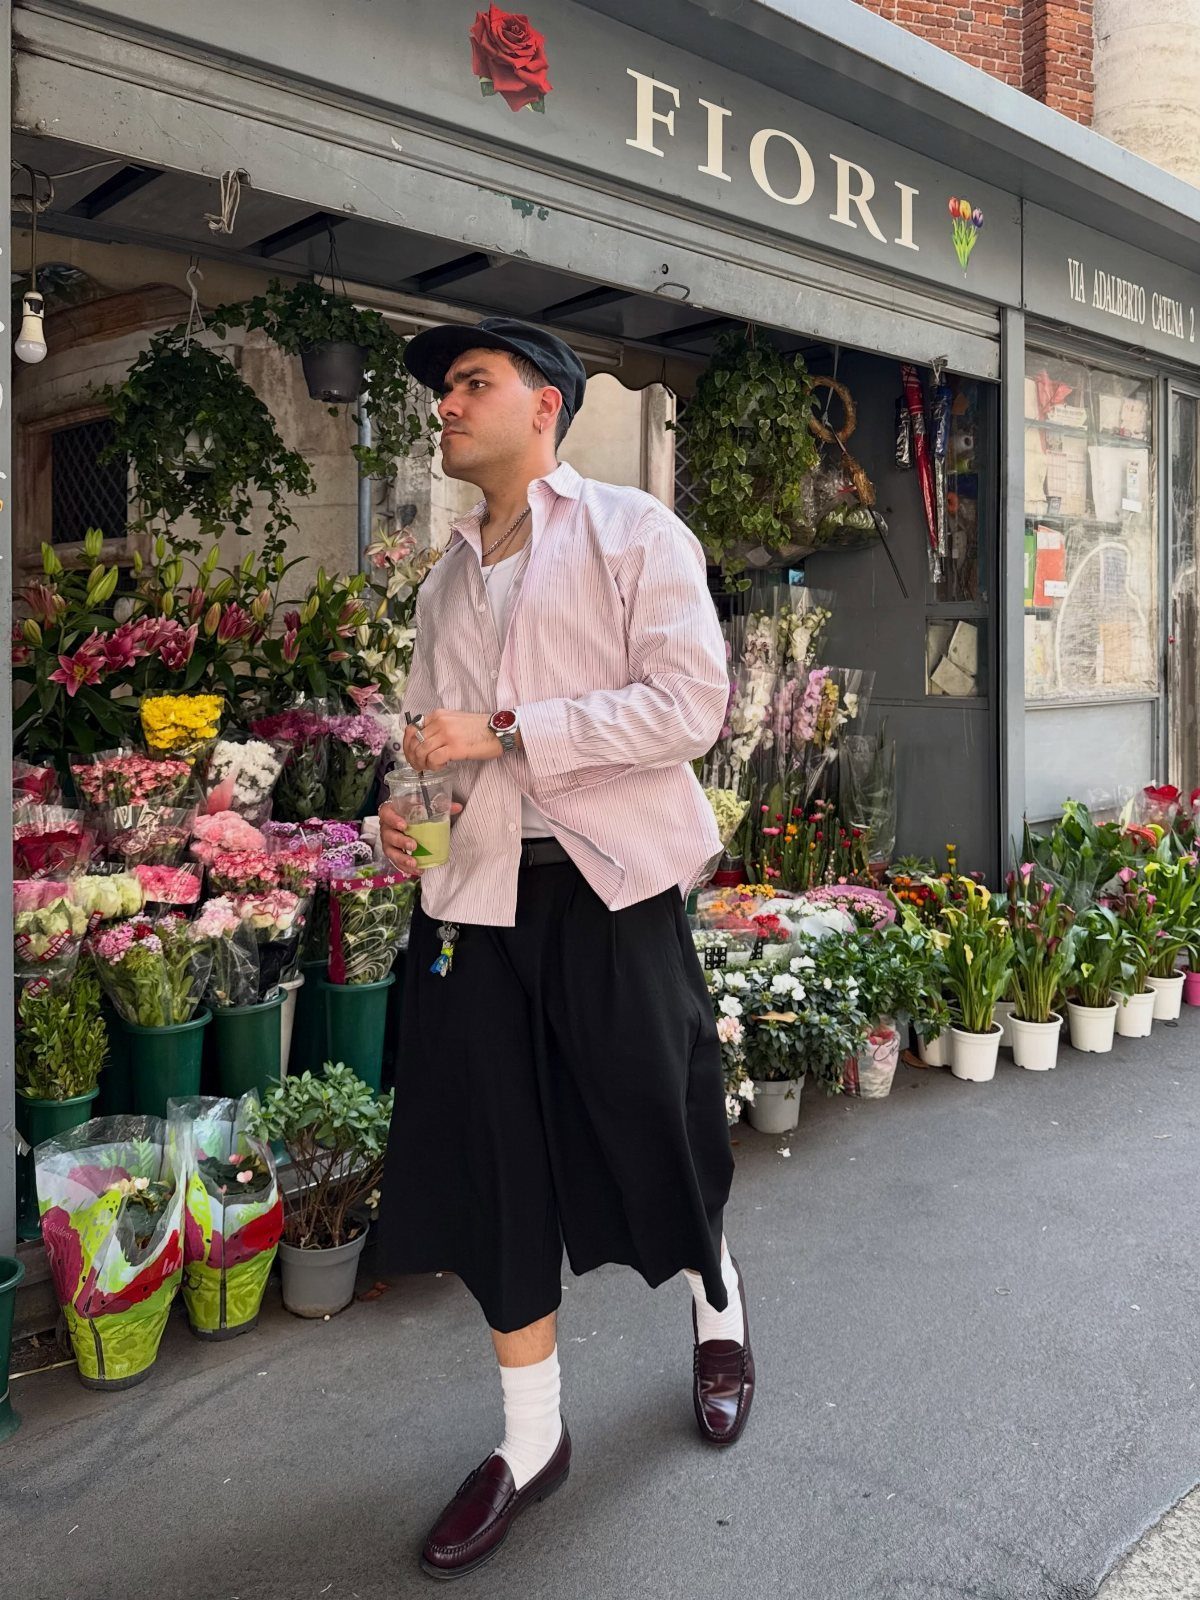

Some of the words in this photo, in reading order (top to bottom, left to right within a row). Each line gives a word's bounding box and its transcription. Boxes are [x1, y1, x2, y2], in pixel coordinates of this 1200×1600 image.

[626, 67, 920, 251] FIORI
[1067, 258, 1086, 303] VIA
[1092, 269, 1146, 325] ADALBERTO
[1151, 292, 1184, 339] CATENA
[43, 932, 71, 960] ALTIMA
